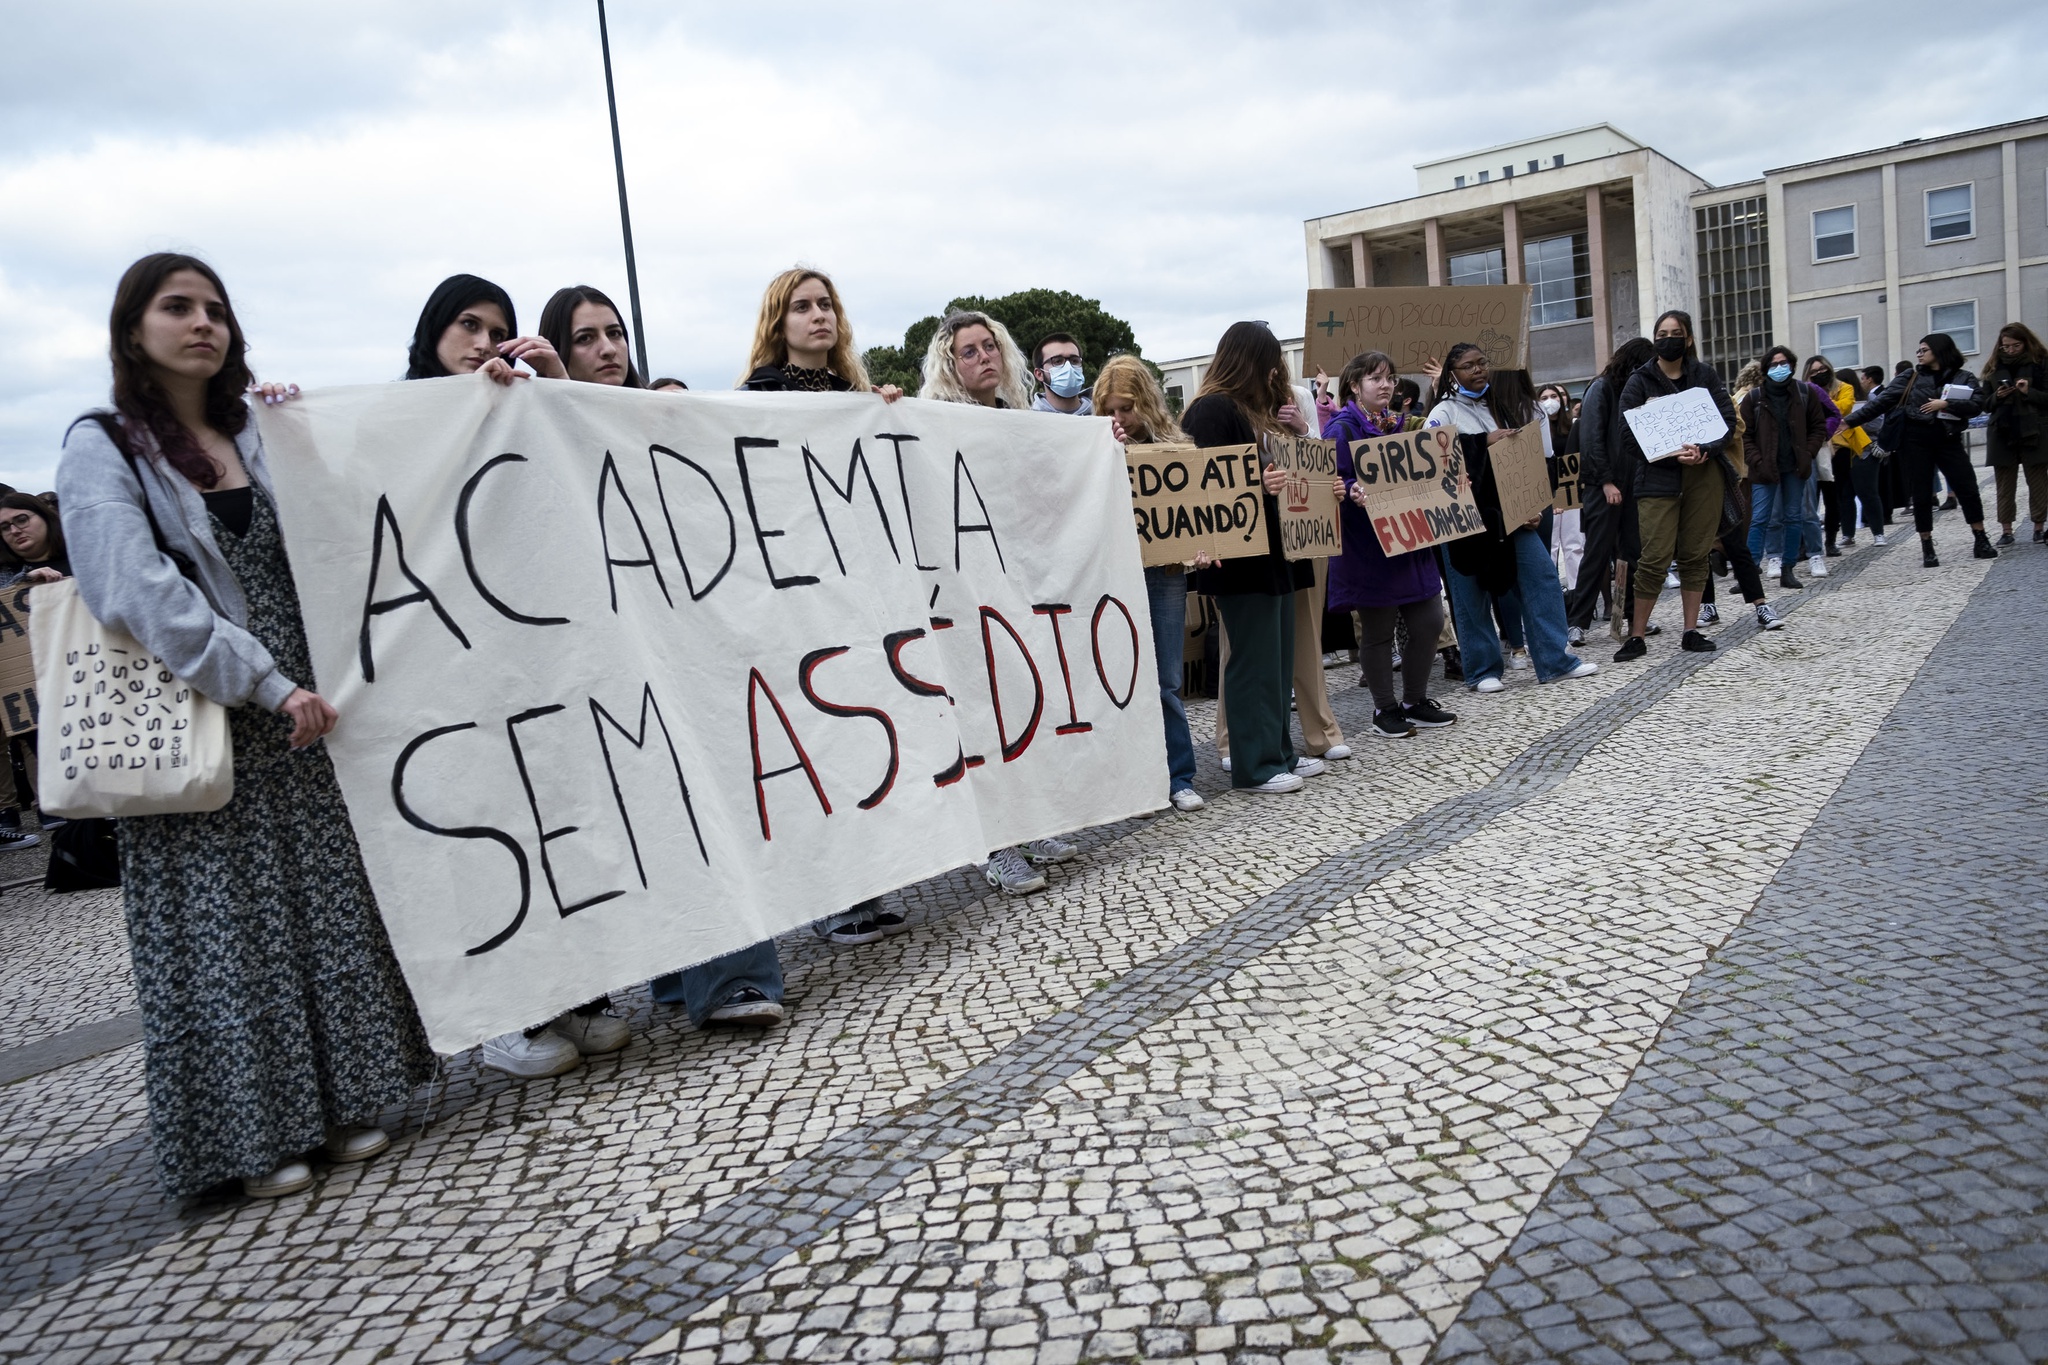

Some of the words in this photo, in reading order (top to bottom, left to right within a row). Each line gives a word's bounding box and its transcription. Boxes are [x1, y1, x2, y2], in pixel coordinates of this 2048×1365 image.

[1400, 297, 1506, 331] PSICOLÓGICO
[1634, 401, 1685, 430] ABUSO
[1644, 422, 1664, 437] DE
[1666, 403, 1713, 427] PODER
[1296, 441, 1336, 475] PESSOAS
[1646, 442, 1663, 456] DE
[1664, 429, 1707, 449] ELOGIO
[1201, 446, 1260, 490] ATÉ
[1286, 471, 1309, 505] NÃO
[1505, 495, 1522, 521] UM
[360, 432, 1007, 683] ACADEMIA
[391, 681, 709, 957] SEM
[748, 584, 1140, 841] ASSÉDIO
